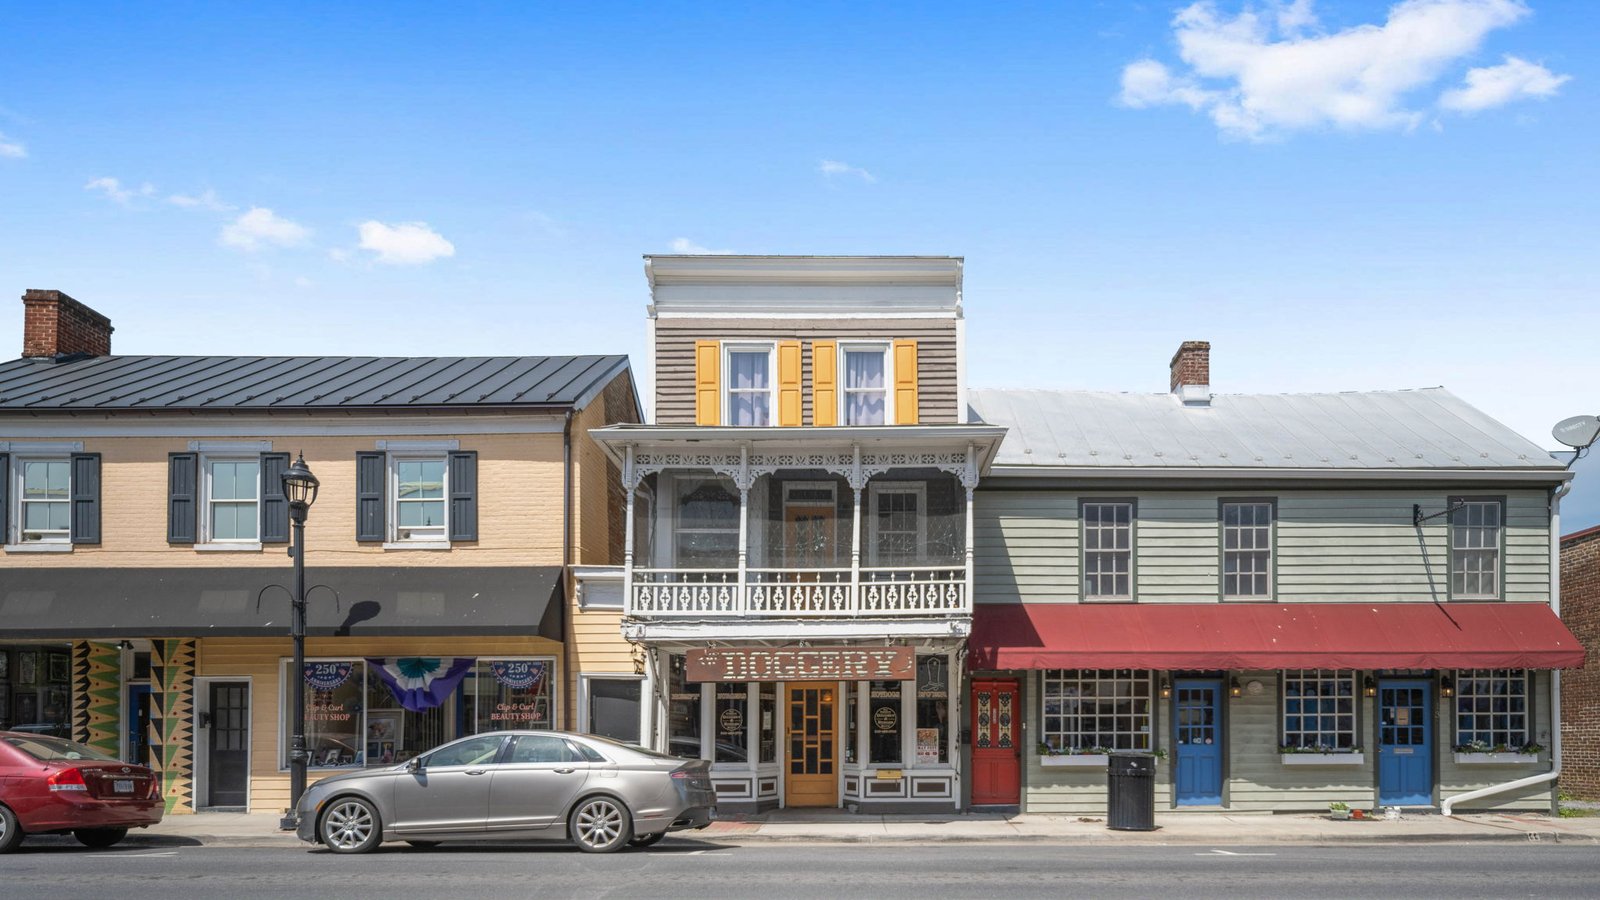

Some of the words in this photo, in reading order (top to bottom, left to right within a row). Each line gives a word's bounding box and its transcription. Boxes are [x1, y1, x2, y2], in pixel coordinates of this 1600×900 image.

[721, 652, 897, 679] DOGGERY
[329, 703, 344, 711] Curl
[497, 703, 511, 712] Clip
[519, 702, 534, 710] Curl
[491, 712, 520, 720] BEAUTY
[521, 712, 541, 720] SHOP
